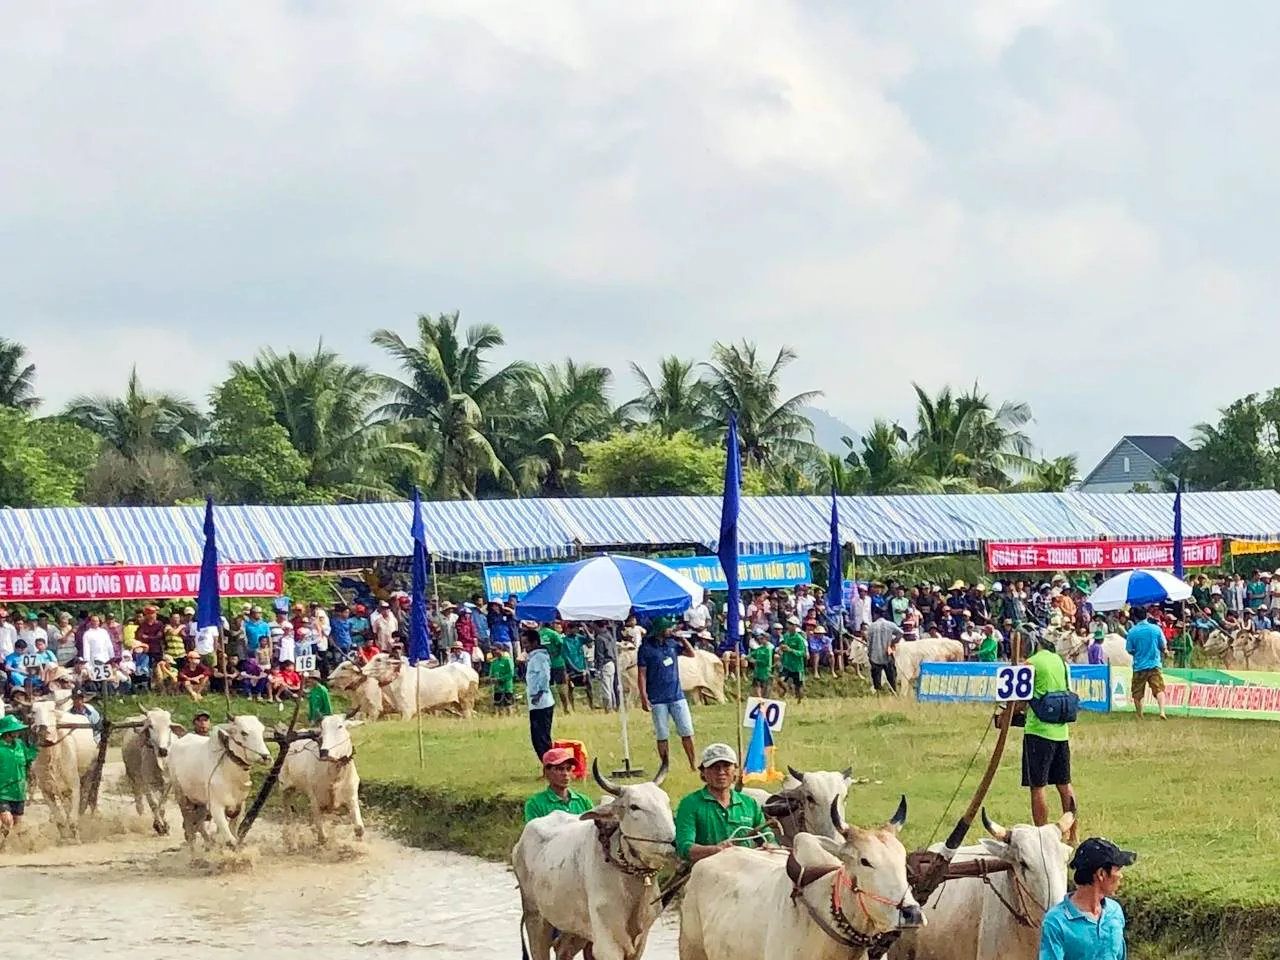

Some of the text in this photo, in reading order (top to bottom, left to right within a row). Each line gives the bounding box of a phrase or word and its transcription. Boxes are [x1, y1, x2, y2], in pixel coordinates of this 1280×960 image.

[1047, 548, 1078, 565] TRUNG
[1111, 547, 1131, 564] CAO
[39, 572, 71, 595] XÂY
[75, 573, 121, 598] DỰNG
[124, 571, 147, 593] VÀ
[149, 567, 182, 592] BẢO
[233, 566, 276, 592] QUỐC
[23, 655, 37, 667] 07
[299, 656, 313, 669] 16
[93, 665, 112, 680] 25
[998, 667, 1032, 699] 38
